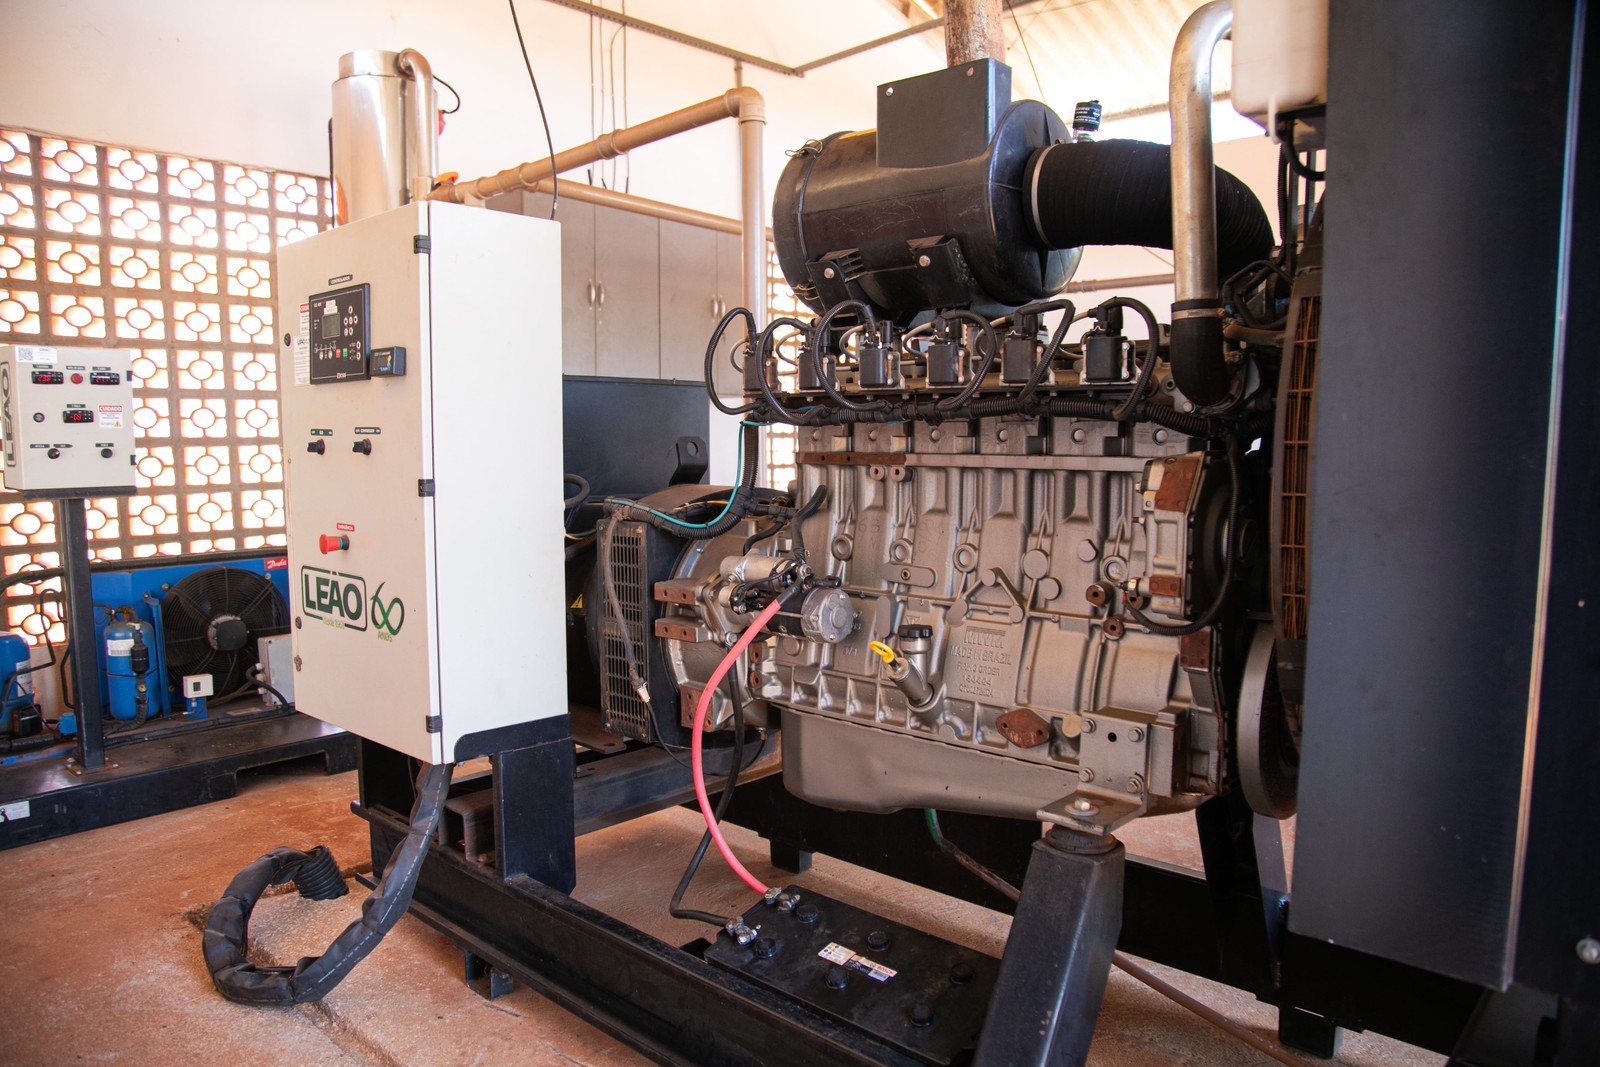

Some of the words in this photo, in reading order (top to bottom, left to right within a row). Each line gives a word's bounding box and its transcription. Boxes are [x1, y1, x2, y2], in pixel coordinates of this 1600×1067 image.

[950, 645, 971, 660] MADE
[973, 649, 981, 661] IN
[982, 650, 1012, 666] BRAZIL
